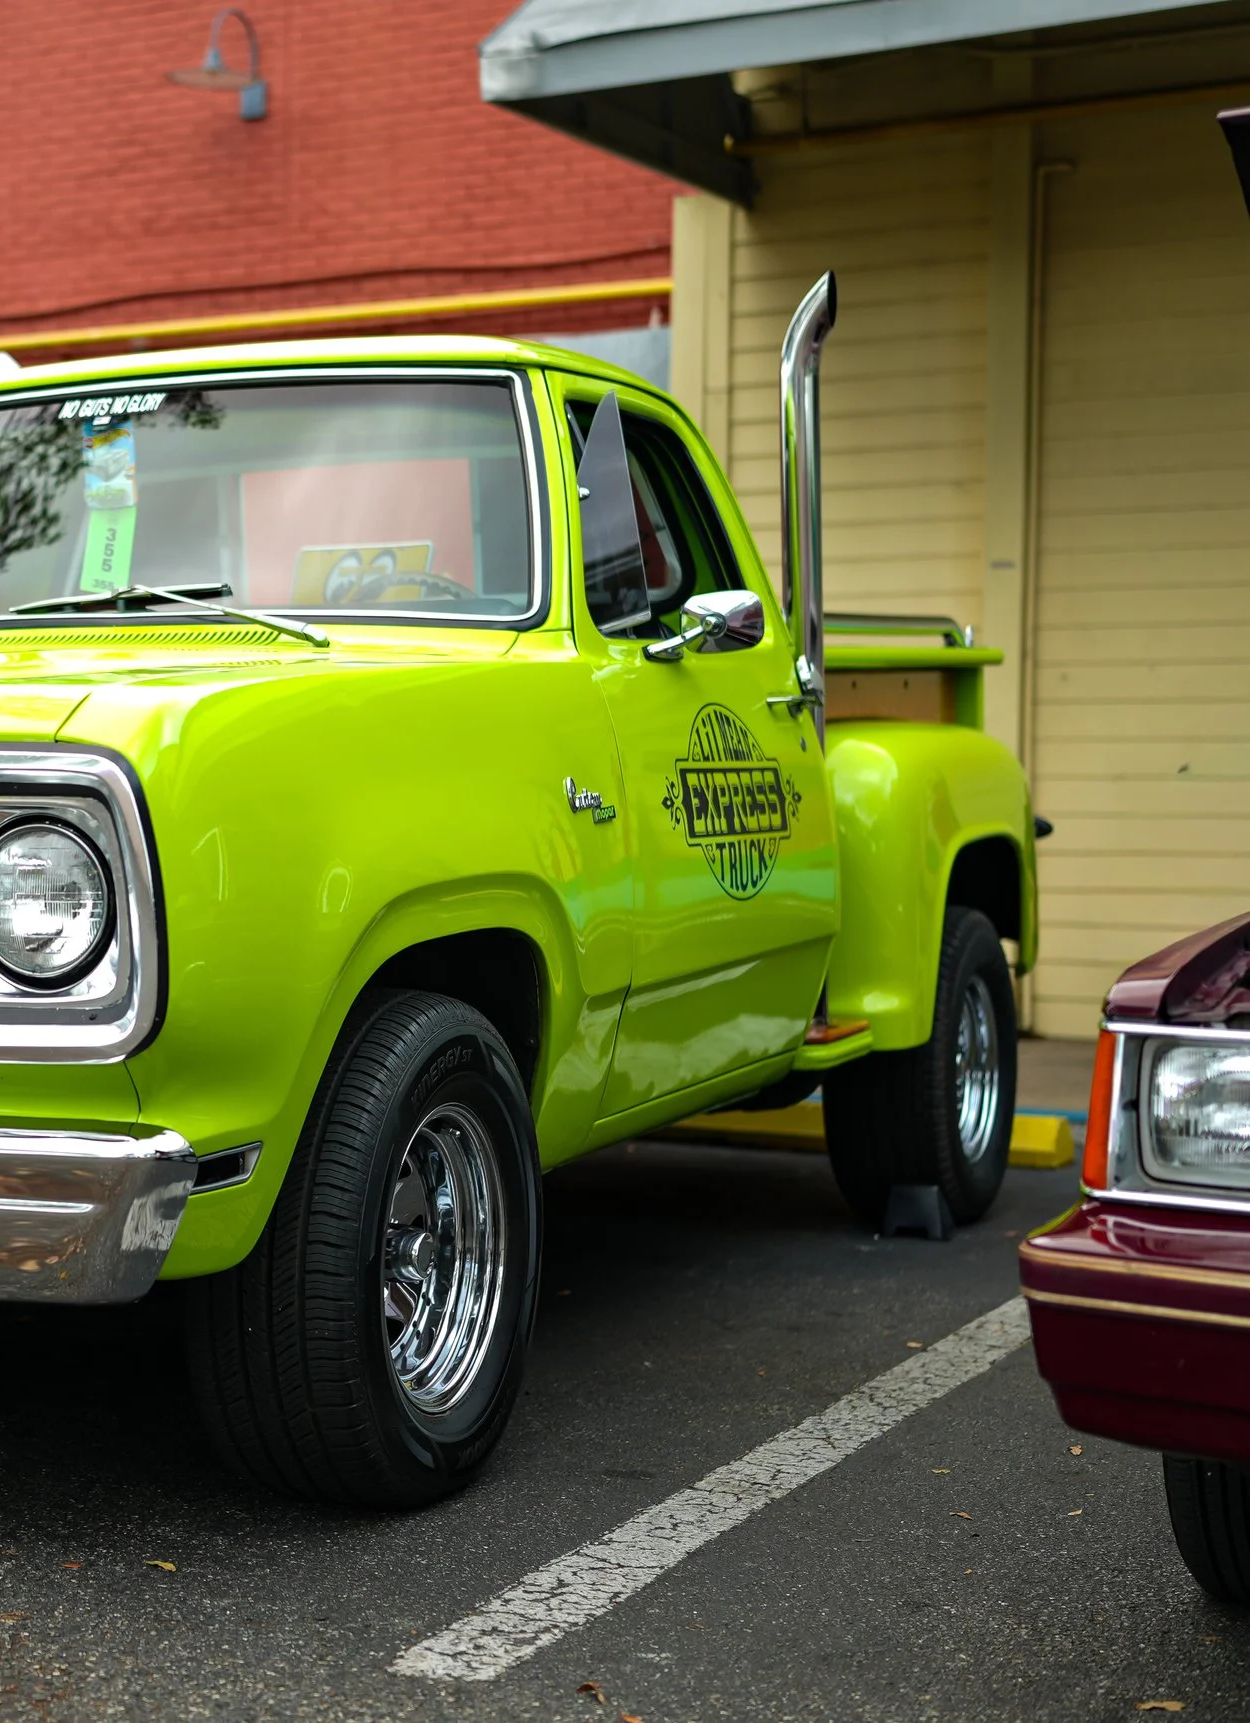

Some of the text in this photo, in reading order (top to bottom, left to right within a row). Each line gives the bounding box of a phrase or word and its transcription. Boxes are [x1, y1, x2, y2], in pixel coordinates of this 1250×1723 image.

[58, 392, 167, 419] NO GUTS NO GLORY
[101, 528, 117, 572] 355
[713, 709, 754, 762] MEAN
[685, 770, 783, 836] EXPRESS
[715, 839, 768, 893] TRUCK
